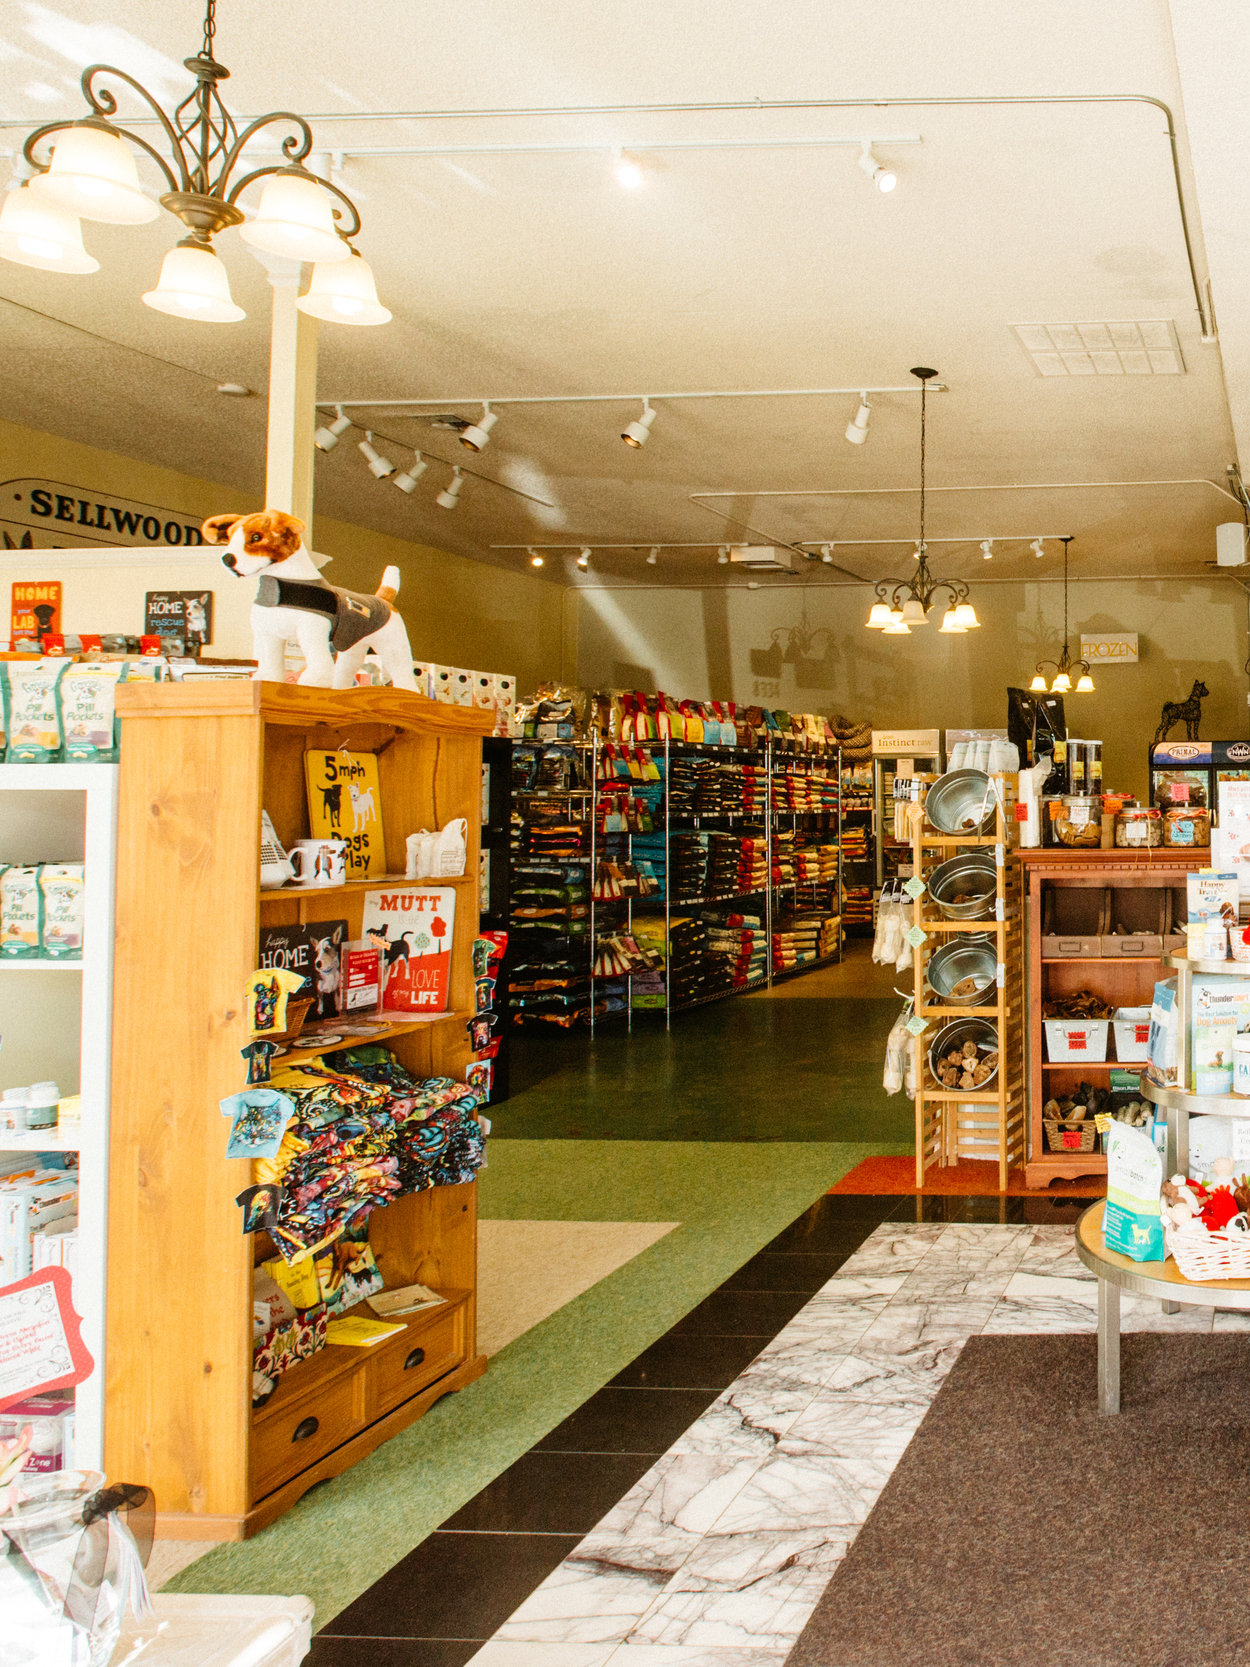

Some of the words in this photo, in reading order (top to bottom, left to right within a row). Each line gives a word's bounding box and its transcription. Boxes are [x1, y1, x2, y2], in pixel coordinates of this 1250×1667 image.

[30, 489, 203, 546] SELLWOOD
[15, 586, 58, 601] HOME
[148, 601, 183, 614] HOME
[13, 615, 35, 629] LAB
[150, 616, 185, 627] rescue
[1081, 642, 1137, 658] FROZEN
[76, 702, 95, 712] Pill
[14, 711, 56, 722] Pockets
[66, 711, 105, 722] Pockets
[877, 738, 915, 748] Instinct
[1171, 748, 1197, 756] PRIMAL
[324, 755, 337, 781] 5
[339, 761, 365, 780] mph
[344, 849, 371, 871] lay
[1200, 881, 1225, 890] Happy
[379, 894, 442, 911] MUTT
[265, 934, 290, 948] happy
[261, 944, 310, 970] HOME
[411, 969, 441, 989] LOVE
[410, 991, 438, 1004] LIFE
[1210, 993, 1250, 1003] thundershirt
[1196, 1017, 1211, 1028] Dog
[1212, 1016, 1238, 1026] Anxiety
